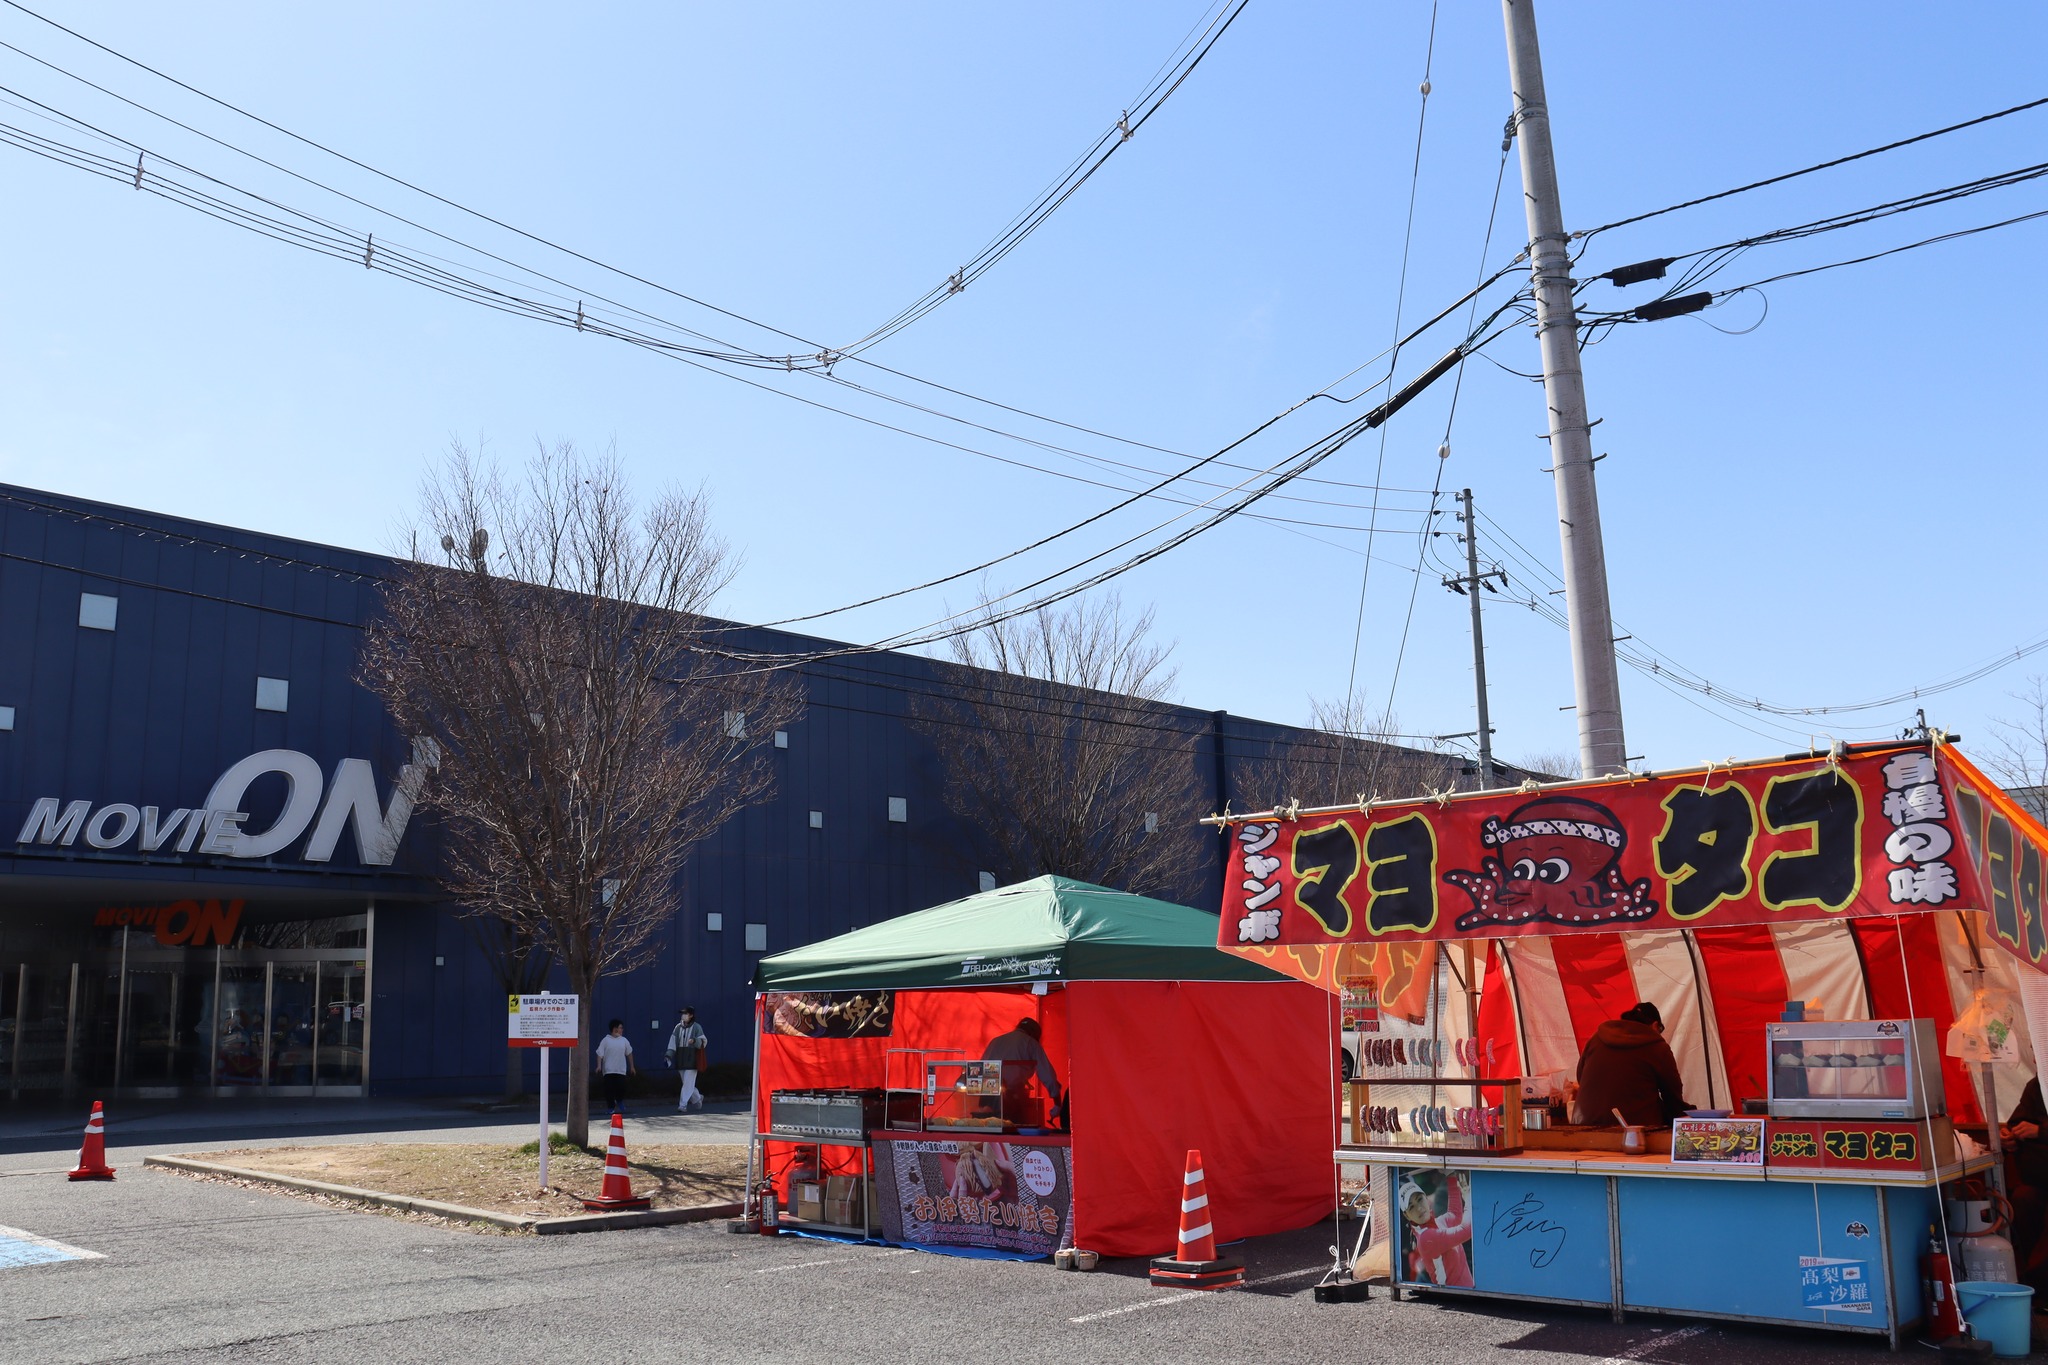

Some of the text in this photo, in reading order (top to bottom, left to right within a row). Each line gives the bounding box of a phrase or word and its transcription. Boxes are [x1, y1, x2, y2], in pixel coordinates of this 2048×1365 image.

[1880, 751, 1960, 905] 自慢の味
[1238, 822, 1283, 943] ジャンボ
[1688, 1133, 1758, 1153] マヨタコ
[1774, 1133, 1812, 1142] 自慢の味
[1824, 1130, 1917, 1161] マヨタコ
[1770, 1142, 1818, 1158] ジャンボ
[914, 1194, 1060, 1235] お伊勢たい焼き
[1800, 1258, 1817, 1267] 2019
[1830, 1282, 1869, 1303] 沙羅
